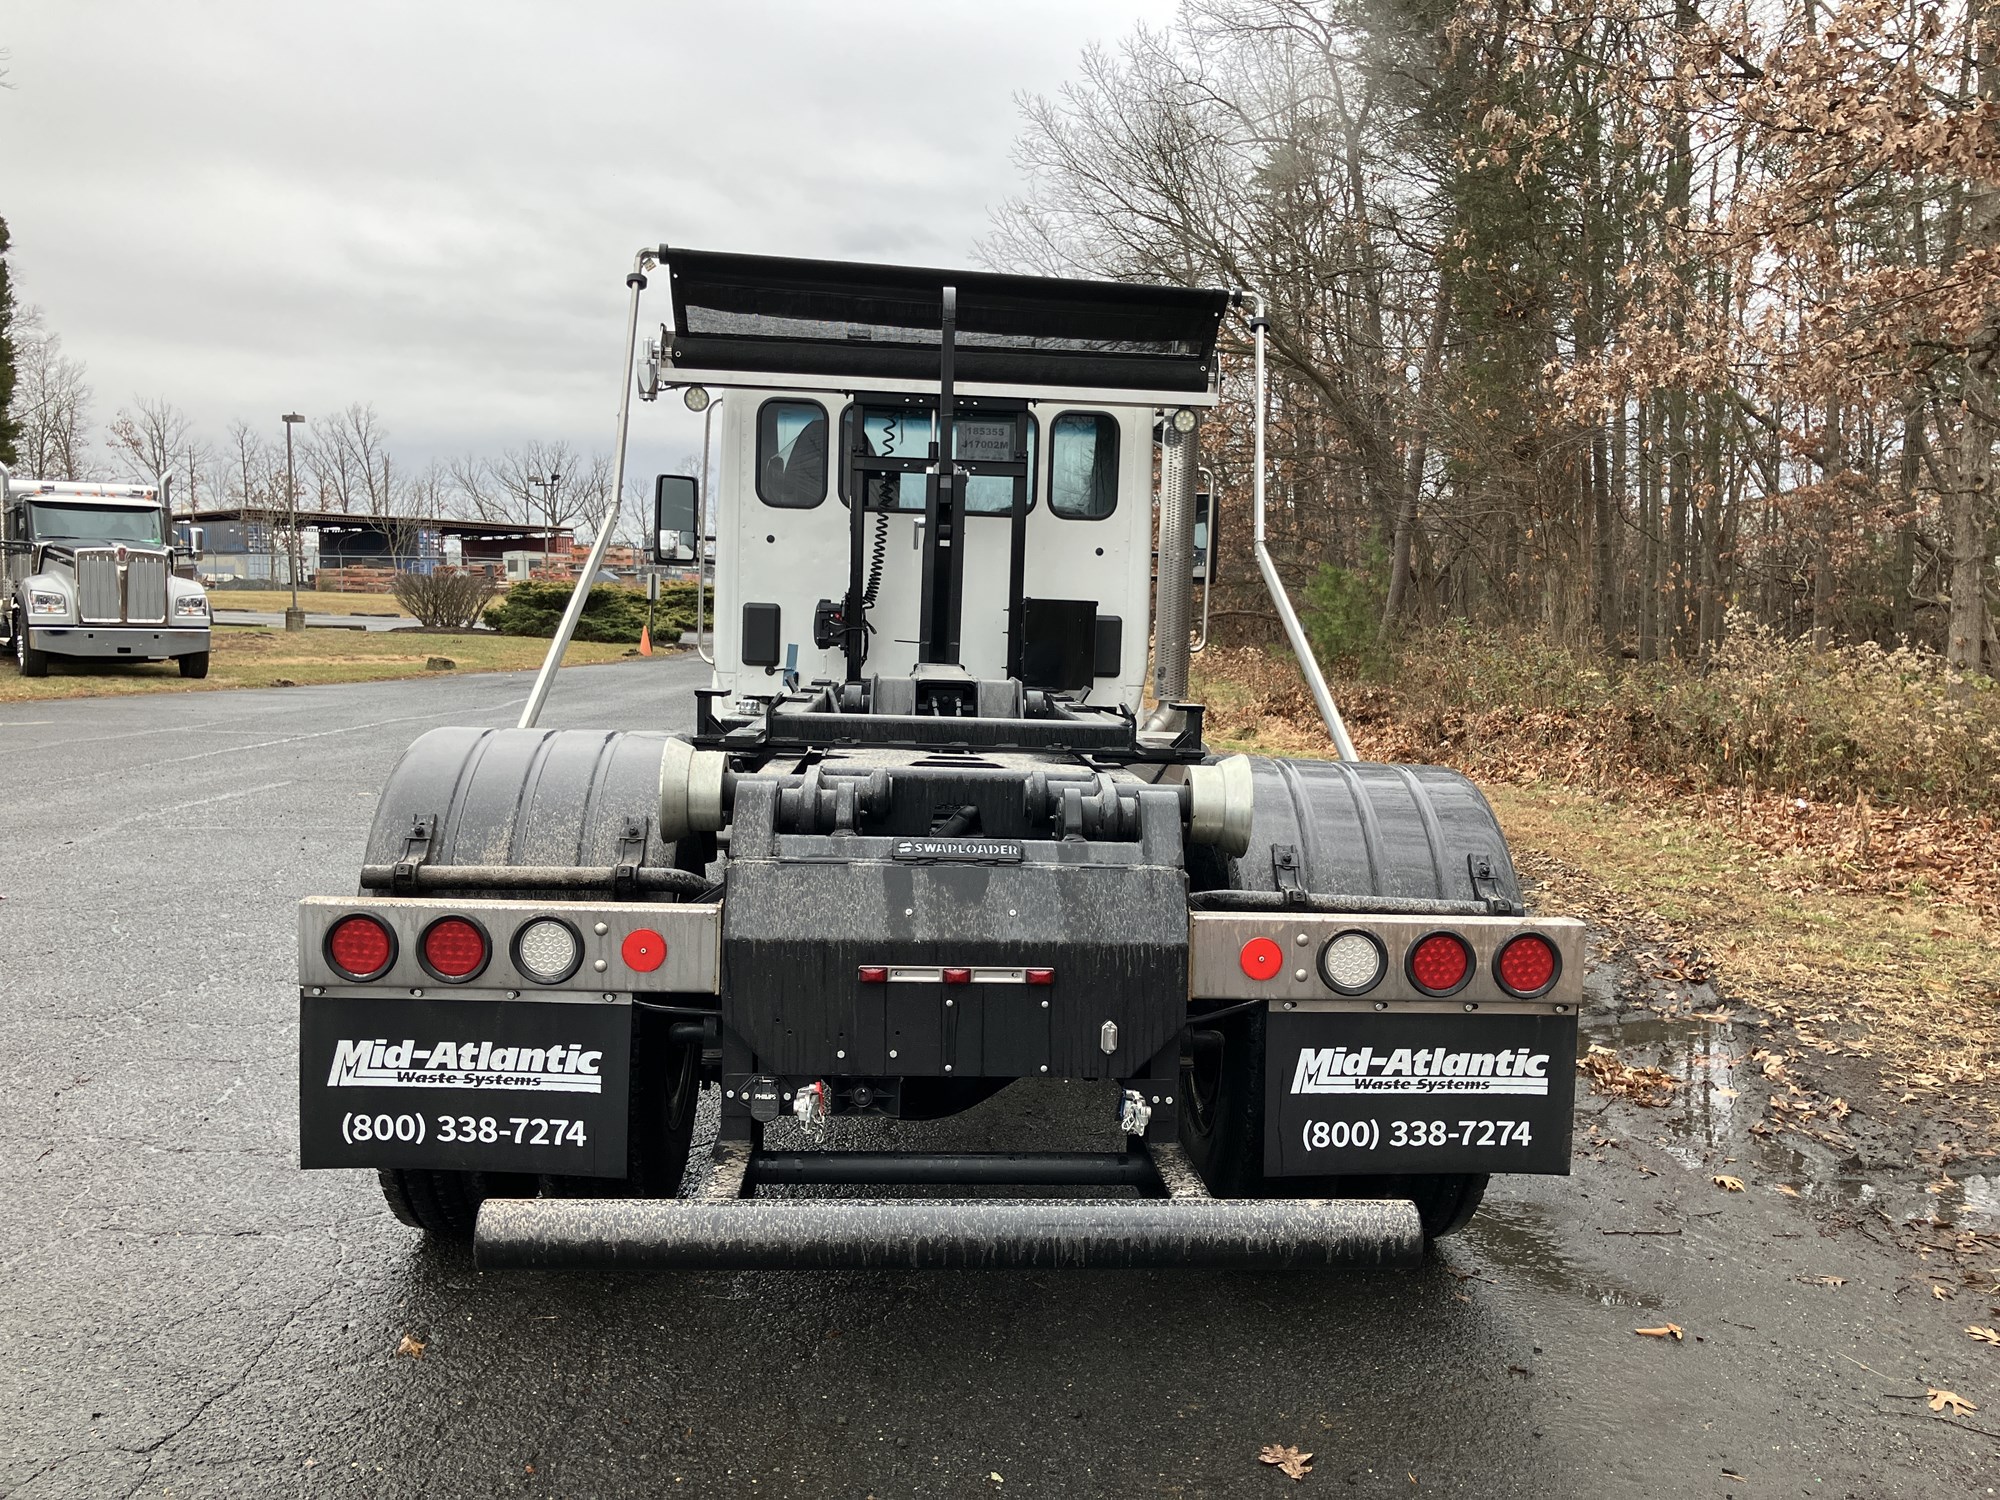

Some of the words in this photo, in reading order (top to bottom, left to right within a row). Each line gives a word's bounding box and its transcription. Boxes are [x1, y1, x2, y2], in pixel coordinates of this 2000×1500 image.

[967, 427, 1005, 436] 185355
[962, 440, 1009, 449] J17002M
[915, 843, 1018, 855] SWAPLOADER
[327, 1038, 603, 1087] Mid-Atlantic
[397, 1071, 457, 1084] Waste
[463, 1072, 542, 1087] Systems
[1290, 1047, 1550, 1095] Mid-Atlantic
[1354, 1078, 1411, 1090] Waste
[1416, 1078, 1490, 1093] Systems
[342, 1112, 426, 1145] (800)
[436, 1115, 587, 1147] 338-7274
[1302, 1119, 1380, 1152] (800)
[1388, 1120, 1533, 1147] 338-7274
